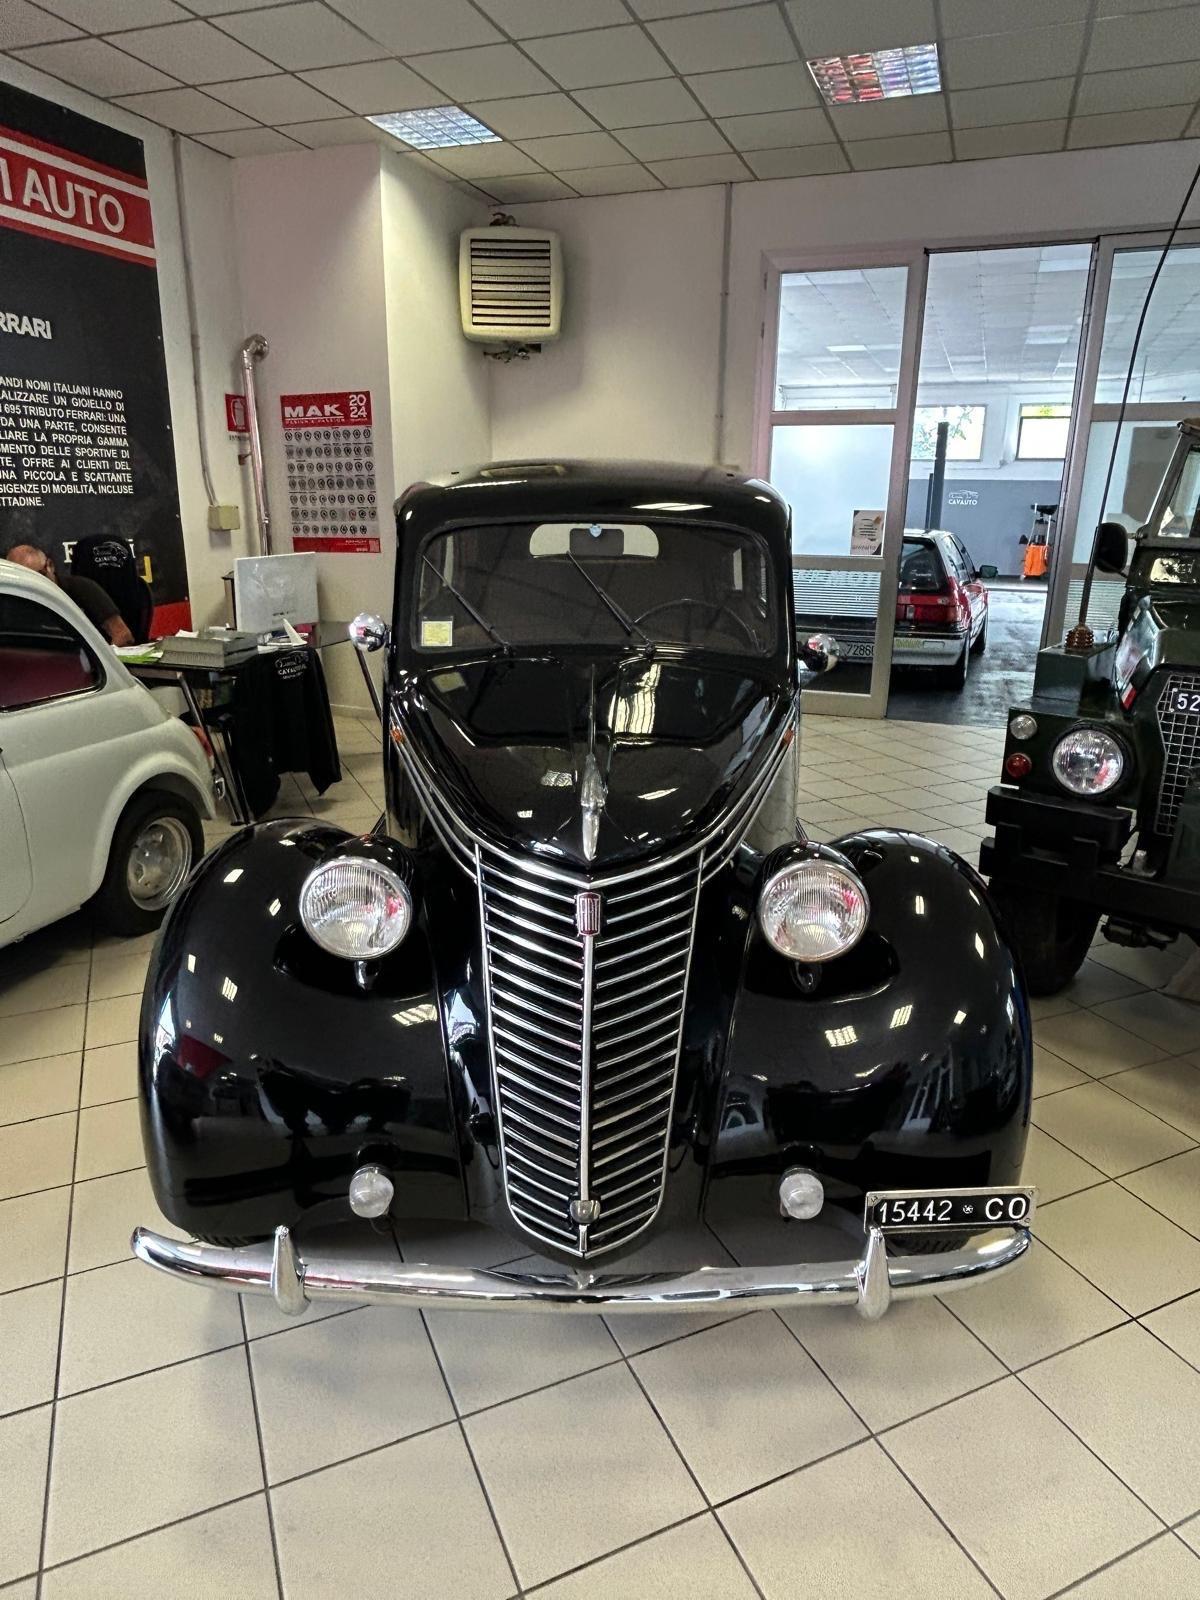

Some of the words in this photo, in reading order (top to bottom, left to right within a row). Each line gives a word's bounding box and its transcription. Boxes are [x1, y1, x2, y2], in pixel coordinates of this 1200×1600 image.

[23, 167, 126, 233] AUTO
[26, 379, 51, 391] NOMI
[53, 383, 91, 396] ITALIANI
[93, 387, 123, 400] HANNO
[0, 390, 49, 404] ALIZZARE
[53, 395, 67, 406] UN
[71, 397, 112, 410] GIOIELLO
[116, 401, 125, 411] DI
[349, 394, 367, 406] 20
[4, 403, 21, 415] 695
[22, 405, 65, 418] TRIBUTO
[66, 409, 107, 421] FERRARI:
[108, 413, 127, 423] UNA
[285, 404, 344, 417] MAK
[350, 406, 368, 418] 24
[19, 418, 41, 429] UNA
[44, 420, 78, 433] PARTE,
[81, 422, 127, 435] CONSENTE
[34, 432, 47, 442] LA
[52, 433, 93, 445] PROPRIA
[97, 436, 129, 447] GAMMA
[40, 445, 71, 456] DELLE
[75, 447, 118, 458] SPORTIVE
[121, 449, 130, 459] DI
[22, 457, 55, 468] OFFRE
[61, 459, 70, 469] AI
[76, 459, 110, 470] CLIENTI
[115, 460, 132, 470] DEL
[23, 470, 66, 481] PICCOLA
[71, 471, 79, 481] E
[84, 471, 133, 482] SCATTANTE
[41, 484, 51, 494] DI
[52, 482, 97, 495] MOBILITÀ,
[98, 484, 134, 494] INCLUSE
[879, 1200, 953, 1223] 15442
[985, 1197, 1027, 1221] CO
